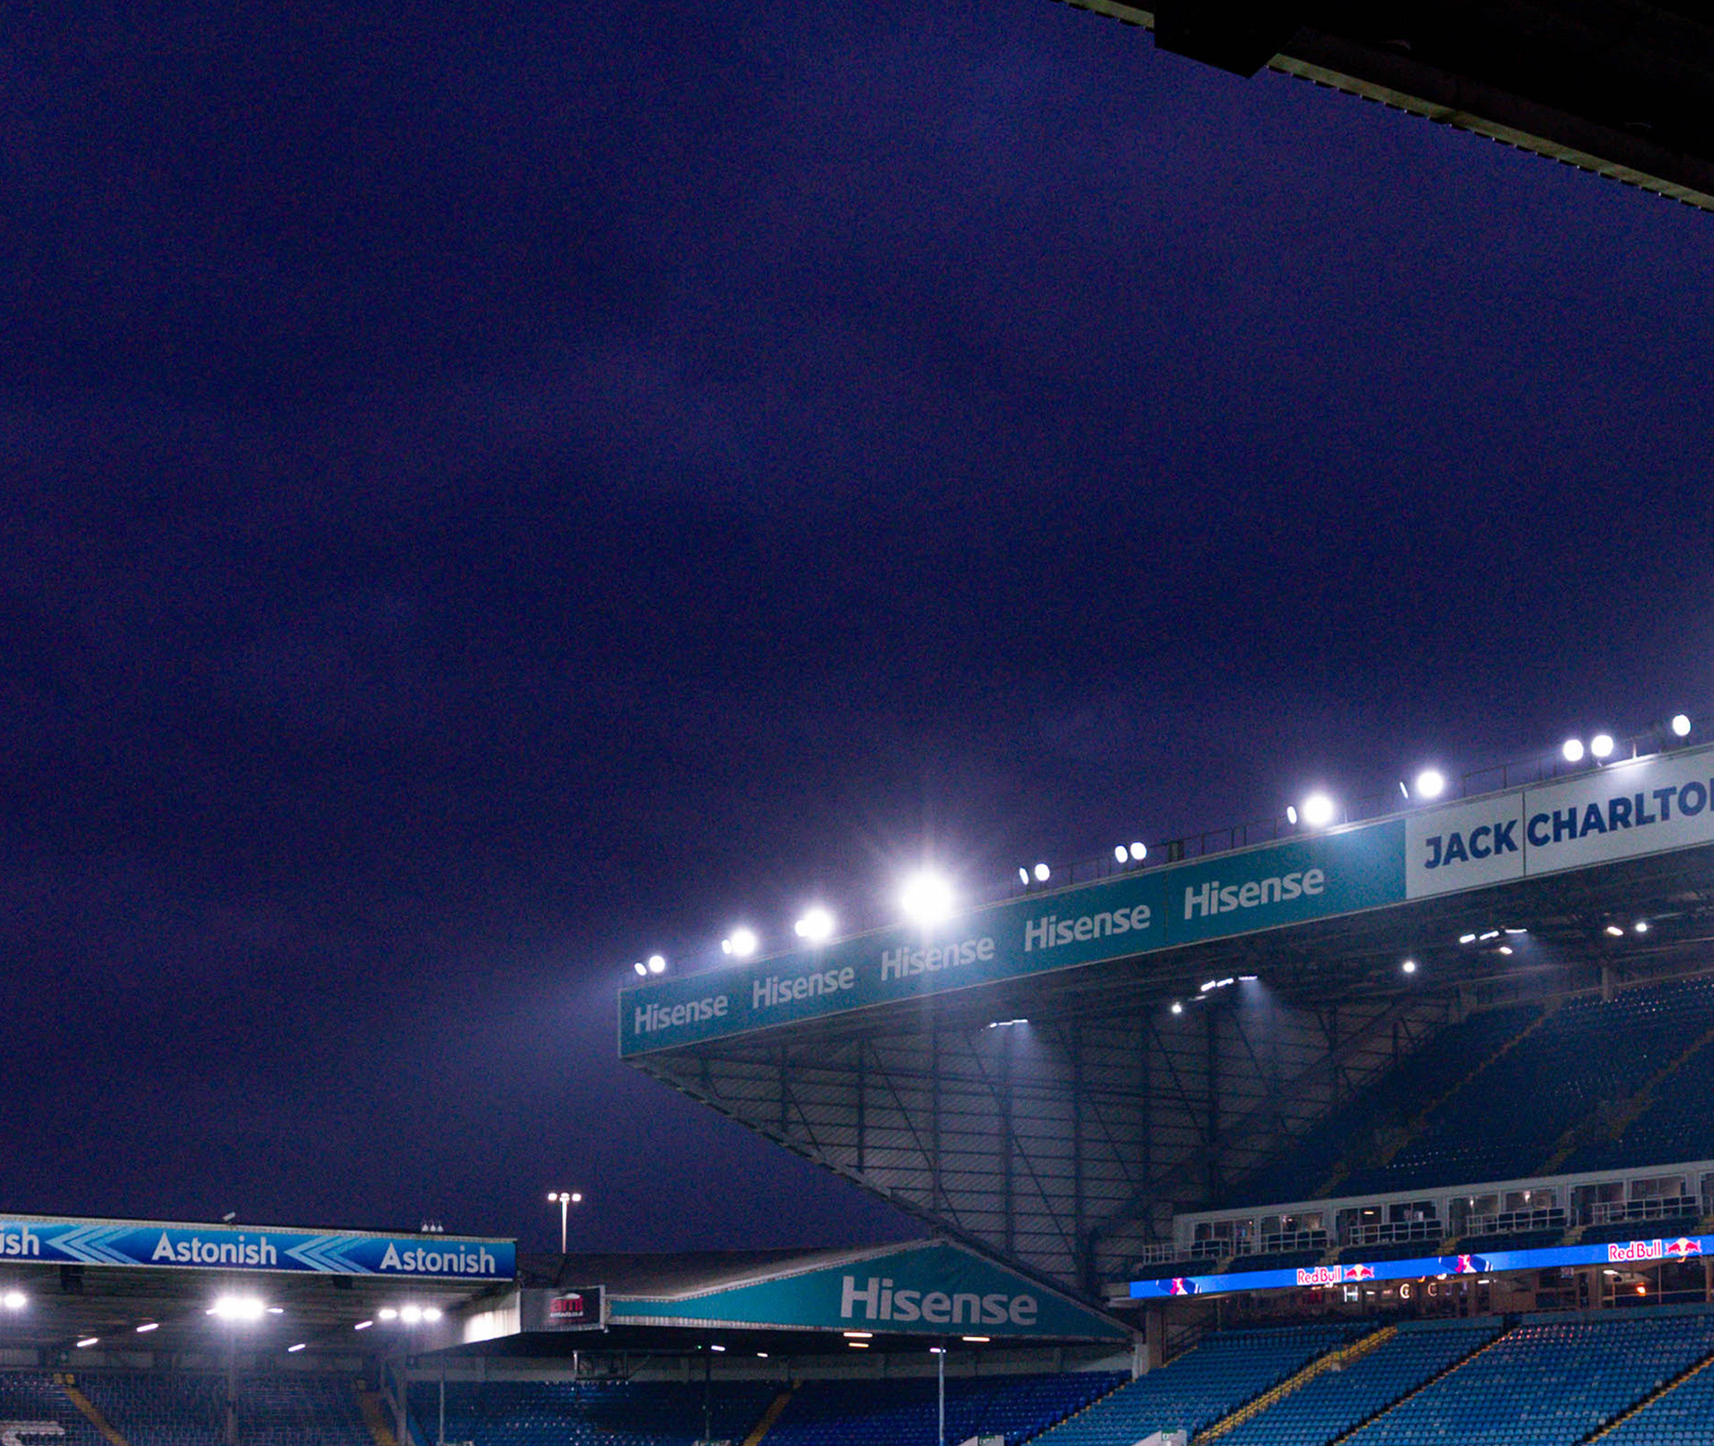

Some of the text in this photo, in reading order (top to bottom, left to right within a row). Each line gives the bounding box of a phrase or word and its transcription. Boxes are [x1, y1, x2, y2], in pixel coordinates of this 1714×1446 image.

[1423, 818, 1519, 870] JACK
[1182, 867, 1325, 920] Hisense
[1023, 903, 1152, 954] Hisense
[879, 933, 996, 982] Hisense
[751, 963, 856, 1010] Hisense
[633, 992, 729, 1036] Hisense
[150, 1230, 278, 1267] Astonish
[379, 1240, 496, 1276] Astonish
[1608, 1239, 1662, 1261] Red Bull
[1297, 1264, 1342, 1285] Red Bull
[839, 1275, 1038, 1326] Hisense
